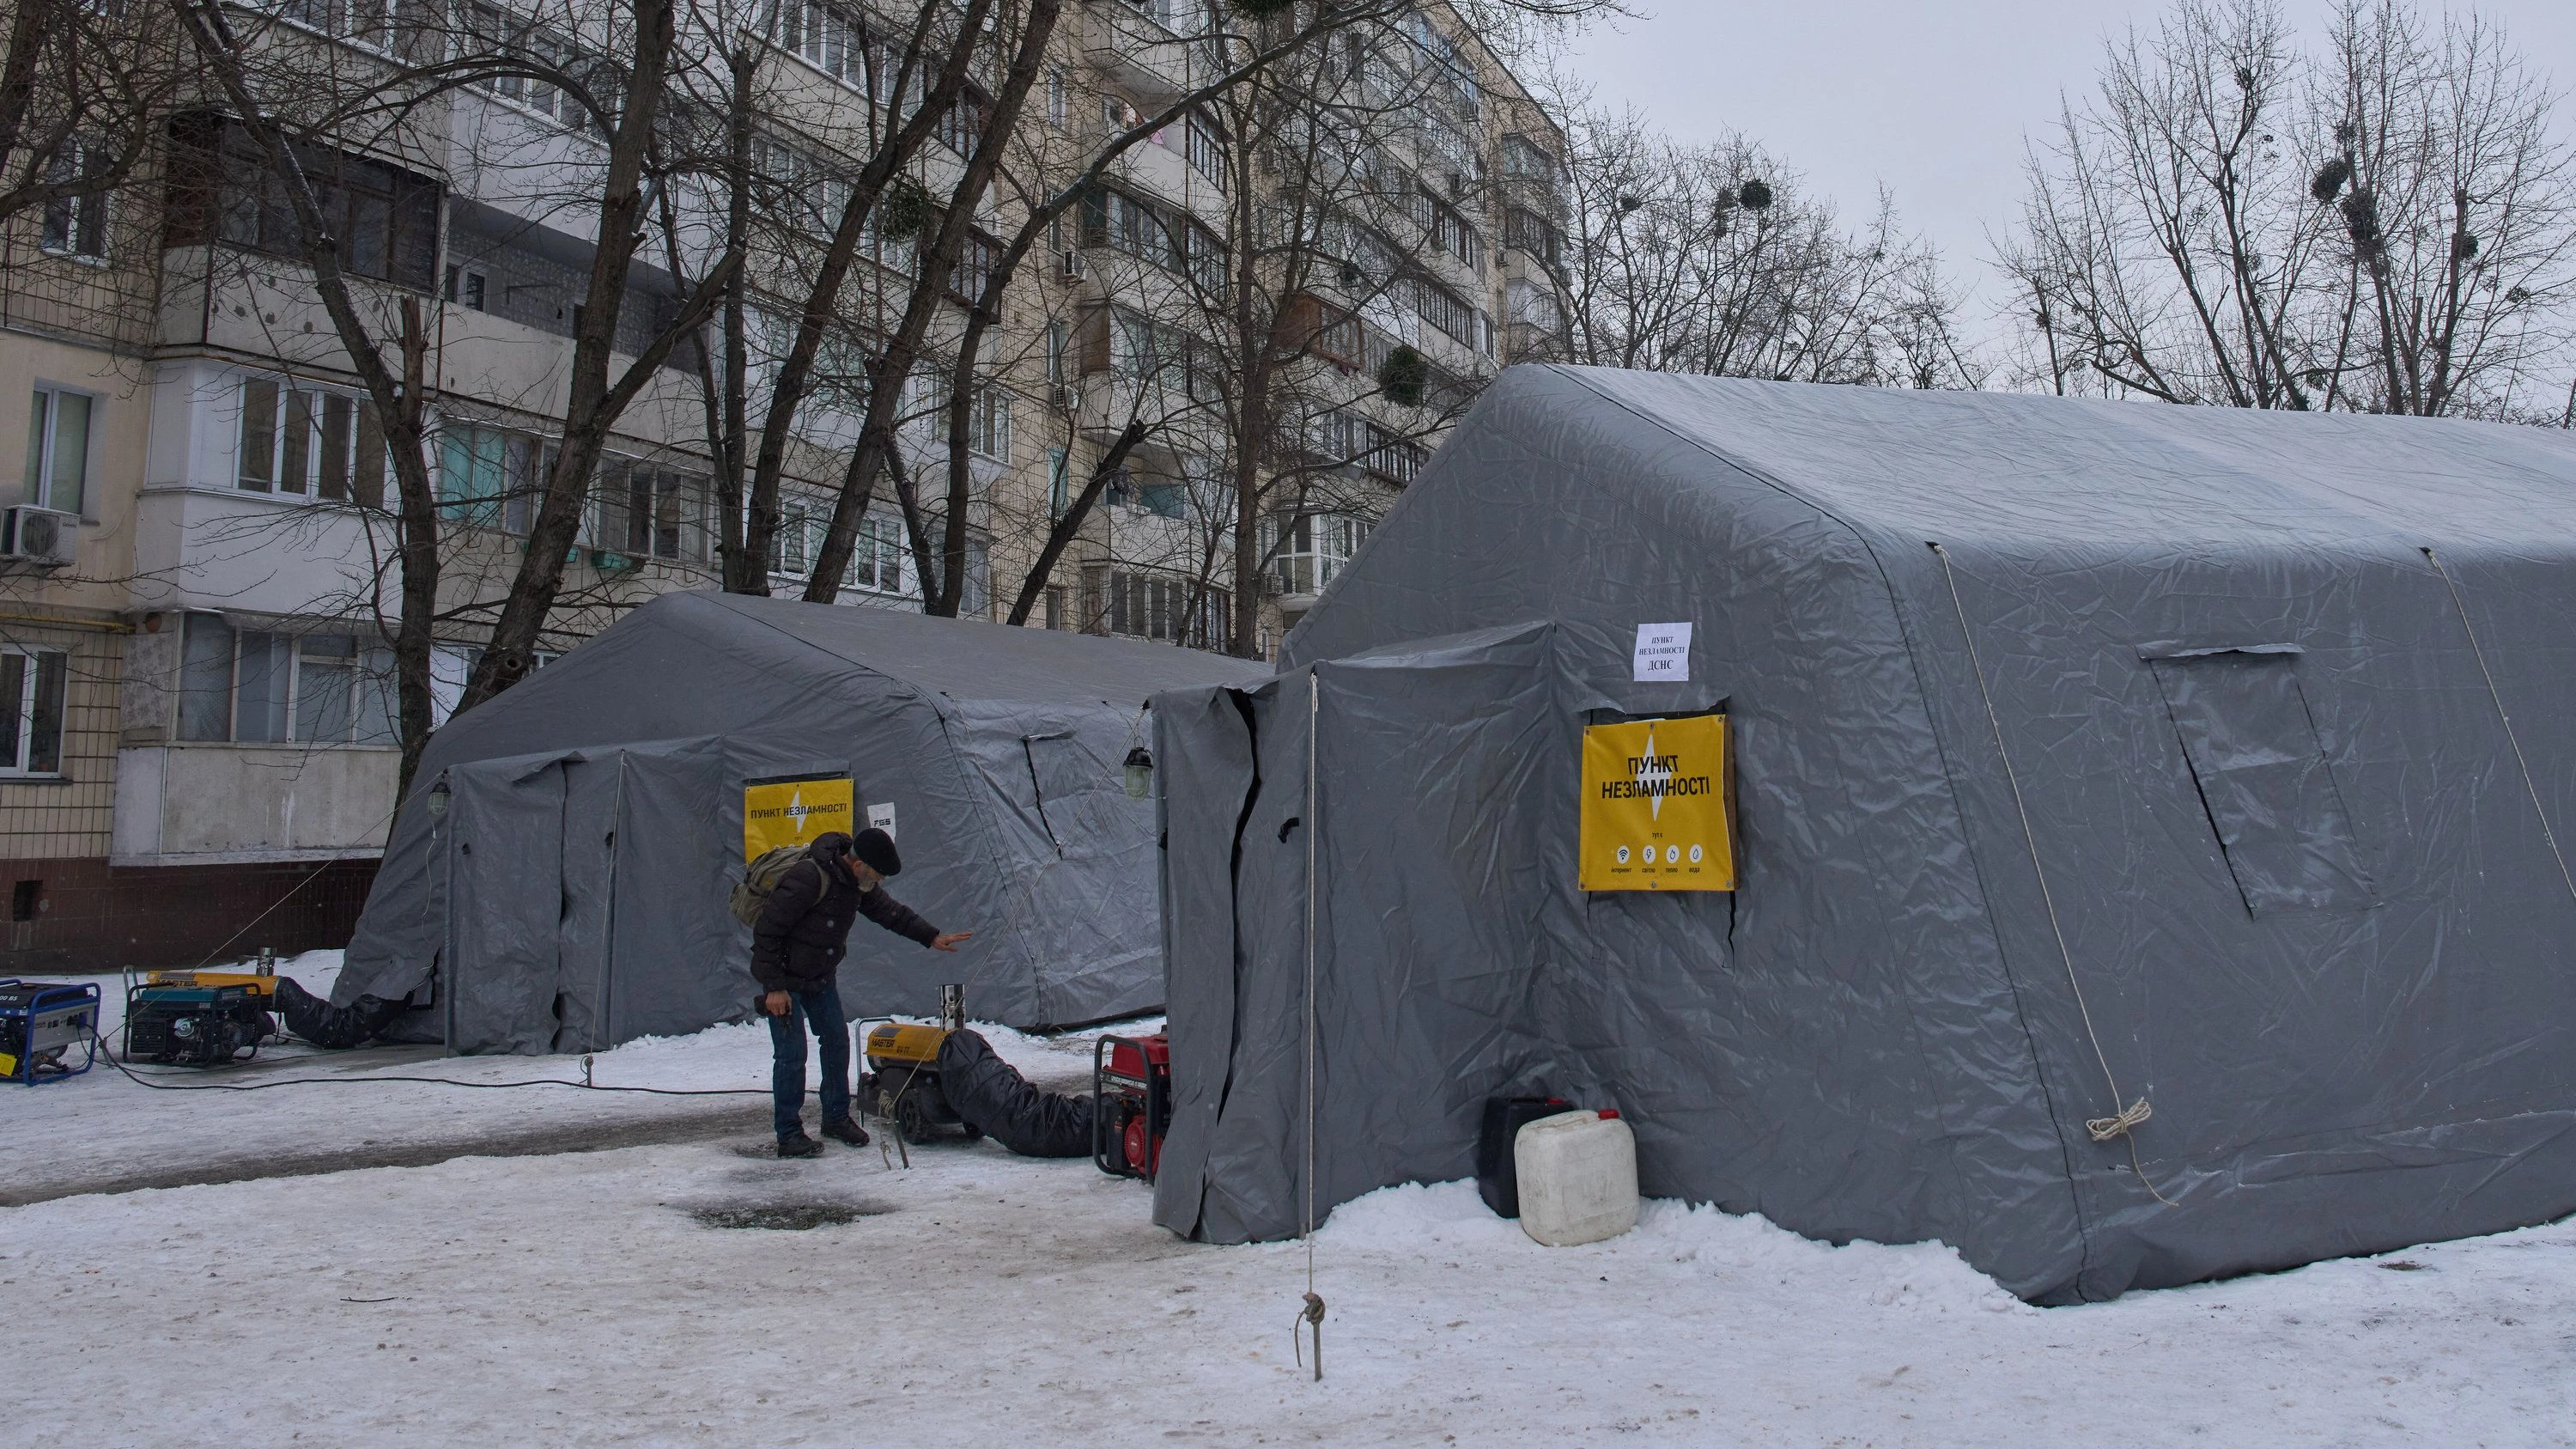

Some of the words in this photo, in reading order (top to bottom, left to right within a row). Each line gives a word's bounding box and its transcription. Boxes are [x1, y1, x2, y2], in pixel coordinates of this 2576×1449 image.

[1639, 646, 1685, 654] НЕЗЛАМНОСТІ
[1648, 660, 1674, 671] ДСНС
[1627, 755, 1678, 774] ПУНКТ
[1601, 776, 1710, 799] НЕЗЛАМНОСТІ
[750, 807, 781, 819] ПУНКТ
[783, 803, 848, 817] НЕЗЛАМНОСТІ
[872, 1038, 895, 1047] MASTER
